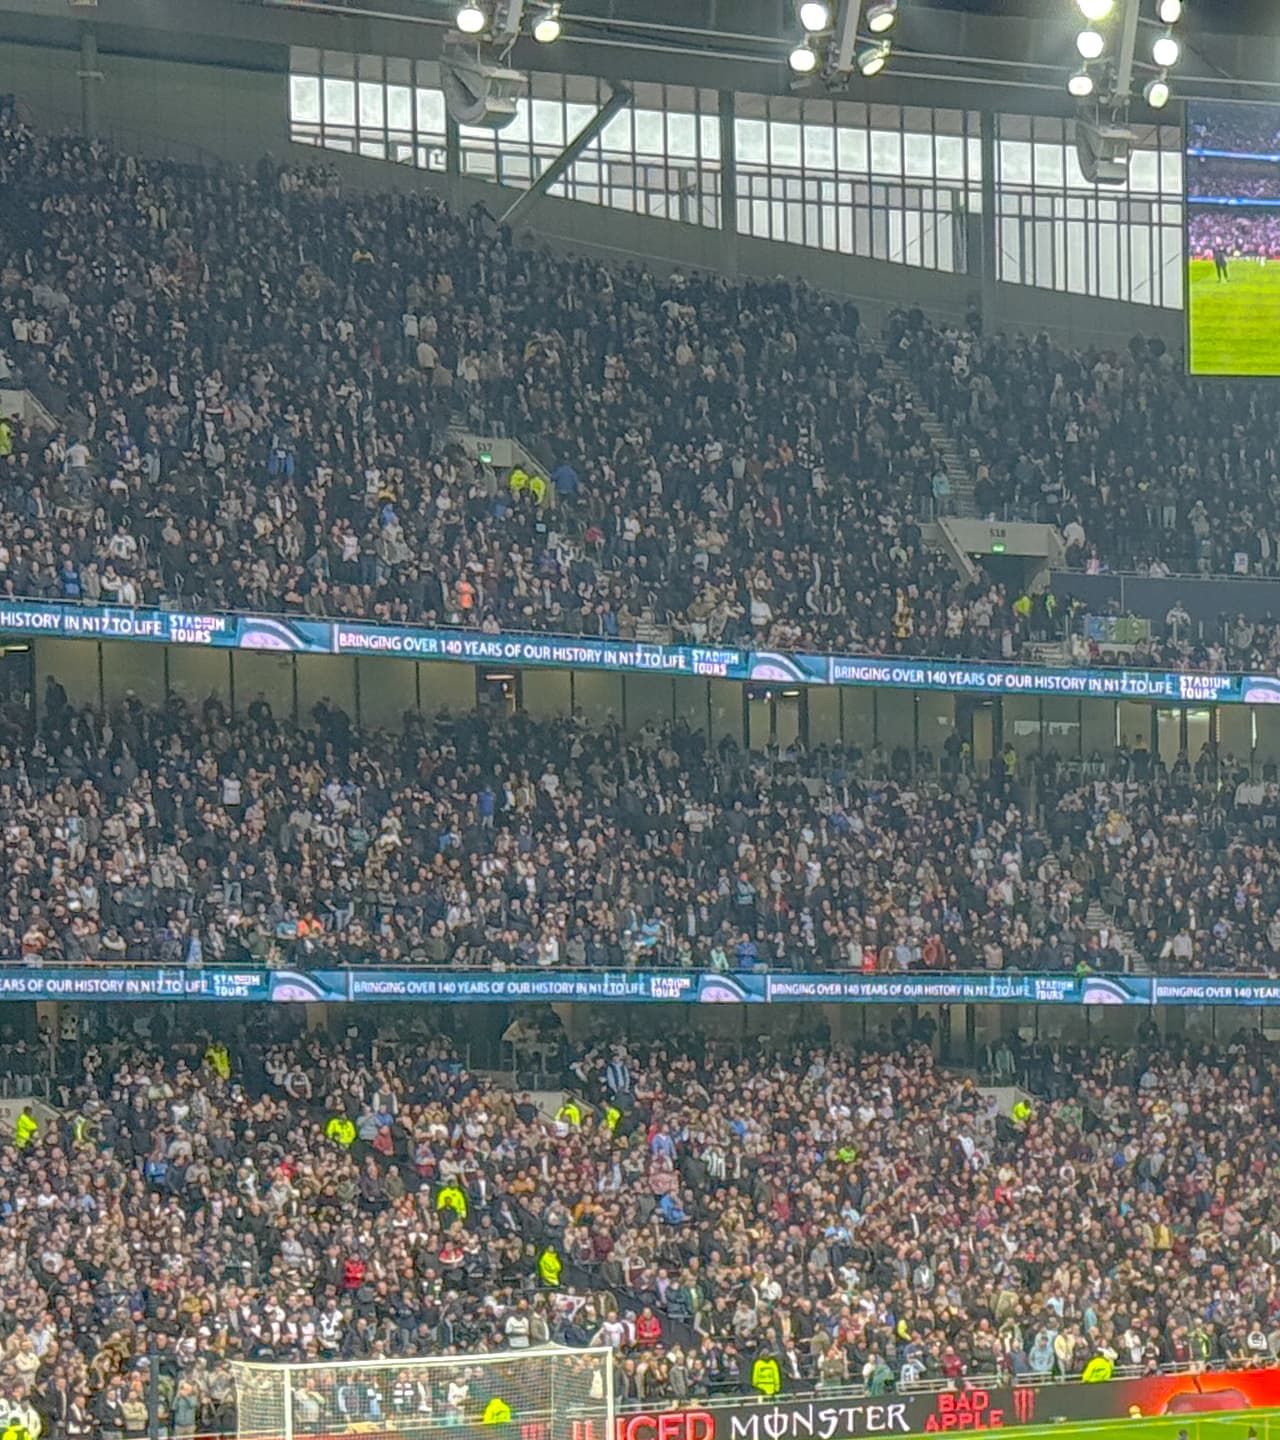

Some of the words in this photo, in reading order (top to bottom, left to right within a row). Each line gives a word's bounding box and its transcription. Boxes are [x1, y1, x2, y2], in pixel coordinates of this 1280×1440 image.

[1, 612, 59, 628] HISTORY
[65, 616, 79, 630] IN
[112, 617, 133, 634] TO
[135, 620, 161, 635] LIFE
[340, 634, 400, 651] BRINGING
[404, 638, 437, 653] OVER
[440, 640, 462, 655] 140
[464, 641, 502, 657] YEARS
[505, 644, 522, 659] OF
[524, 645, 550, 660] OUR
[553, 647, 601, 664] HISTORY
[604, 650, 616, 665] IN
[619, 651, 641, 666] N17
[643, 653, 660, 667] TO
[663, 654, 685, 669] LIFE
[28, 979, 43, 991] OF
[47, 980, 72, 991] OUR
[75, 980, 123, 991] HISTORY
[127, 980, 138, 992] IN
[166, 979, 182, 993] TO
[186, 980, 207, 992] LIFE
[938, 1390, 990, 1412] BAD
[925, 1409, 1004, 1433] APPLE
